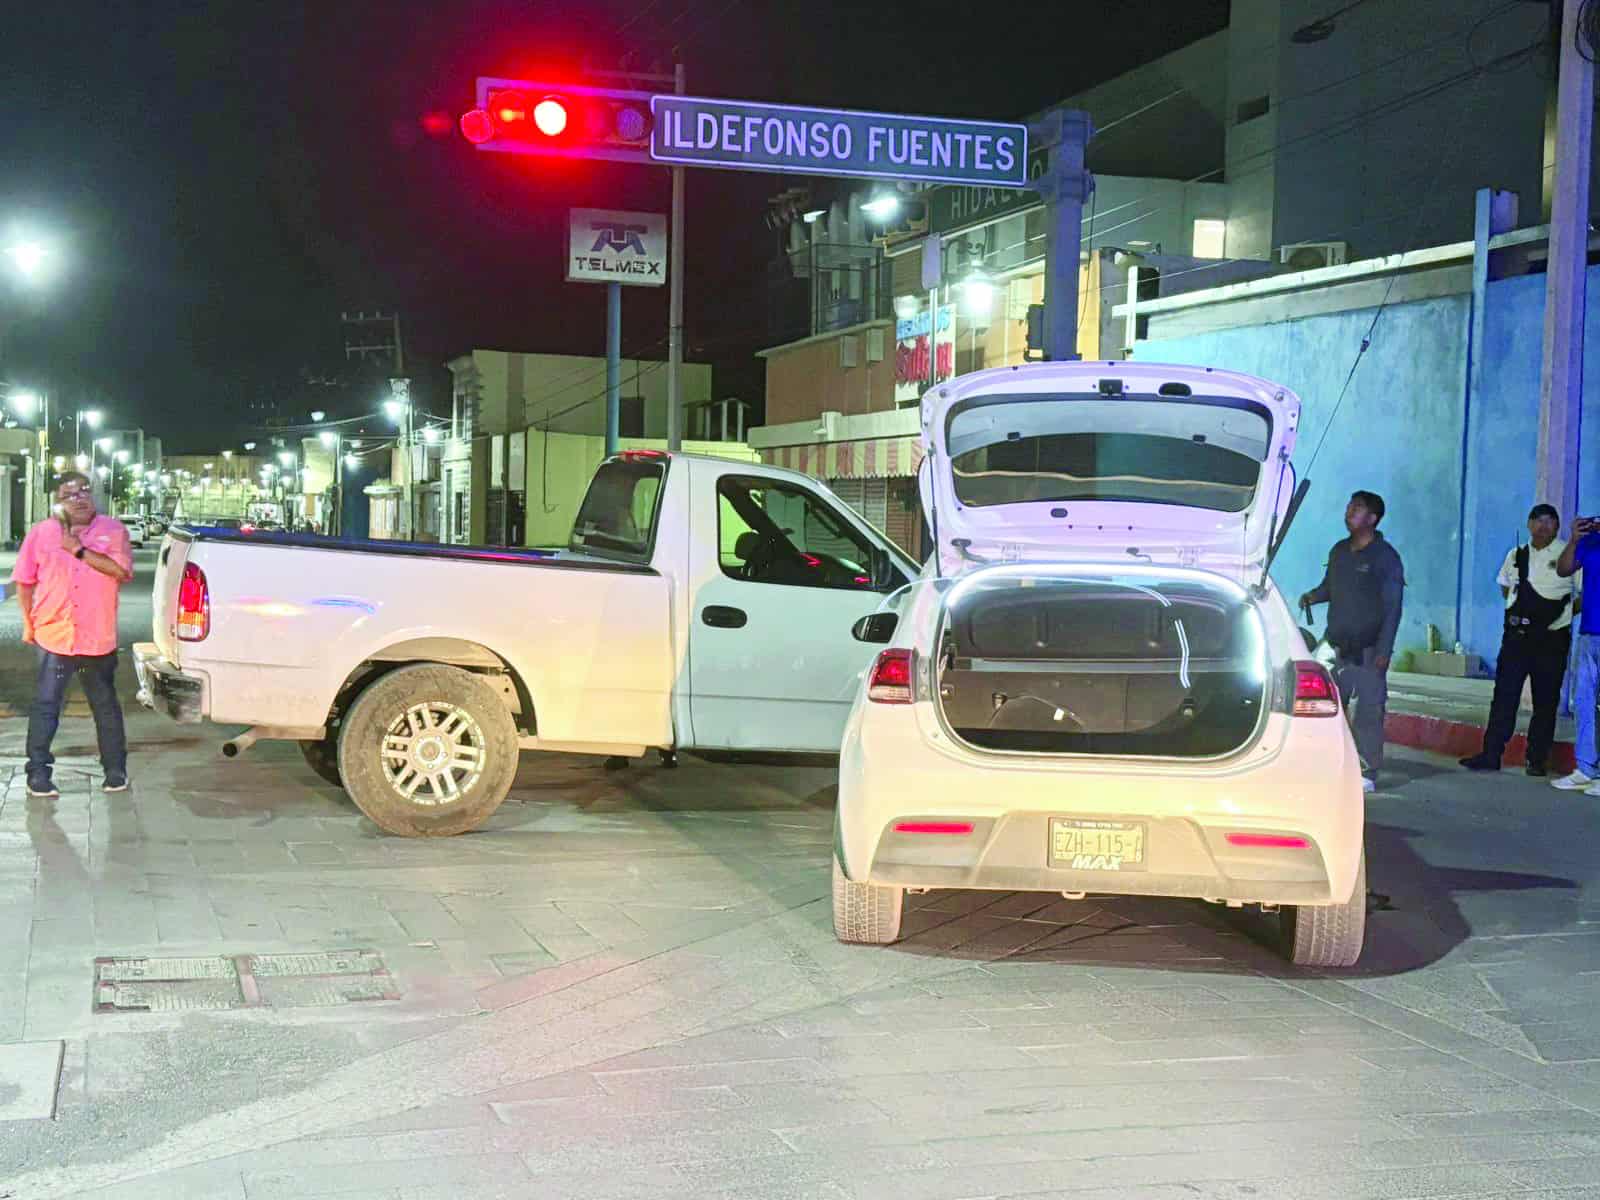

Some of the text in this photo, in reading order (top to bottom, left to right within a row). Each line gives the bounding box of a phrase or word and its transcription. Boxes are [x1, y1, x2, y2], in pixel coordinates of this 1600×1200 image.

[664, 110, 1015, 172] ILDEFONSO FUENTES
[576, 256, 660, 275] TELMEX
